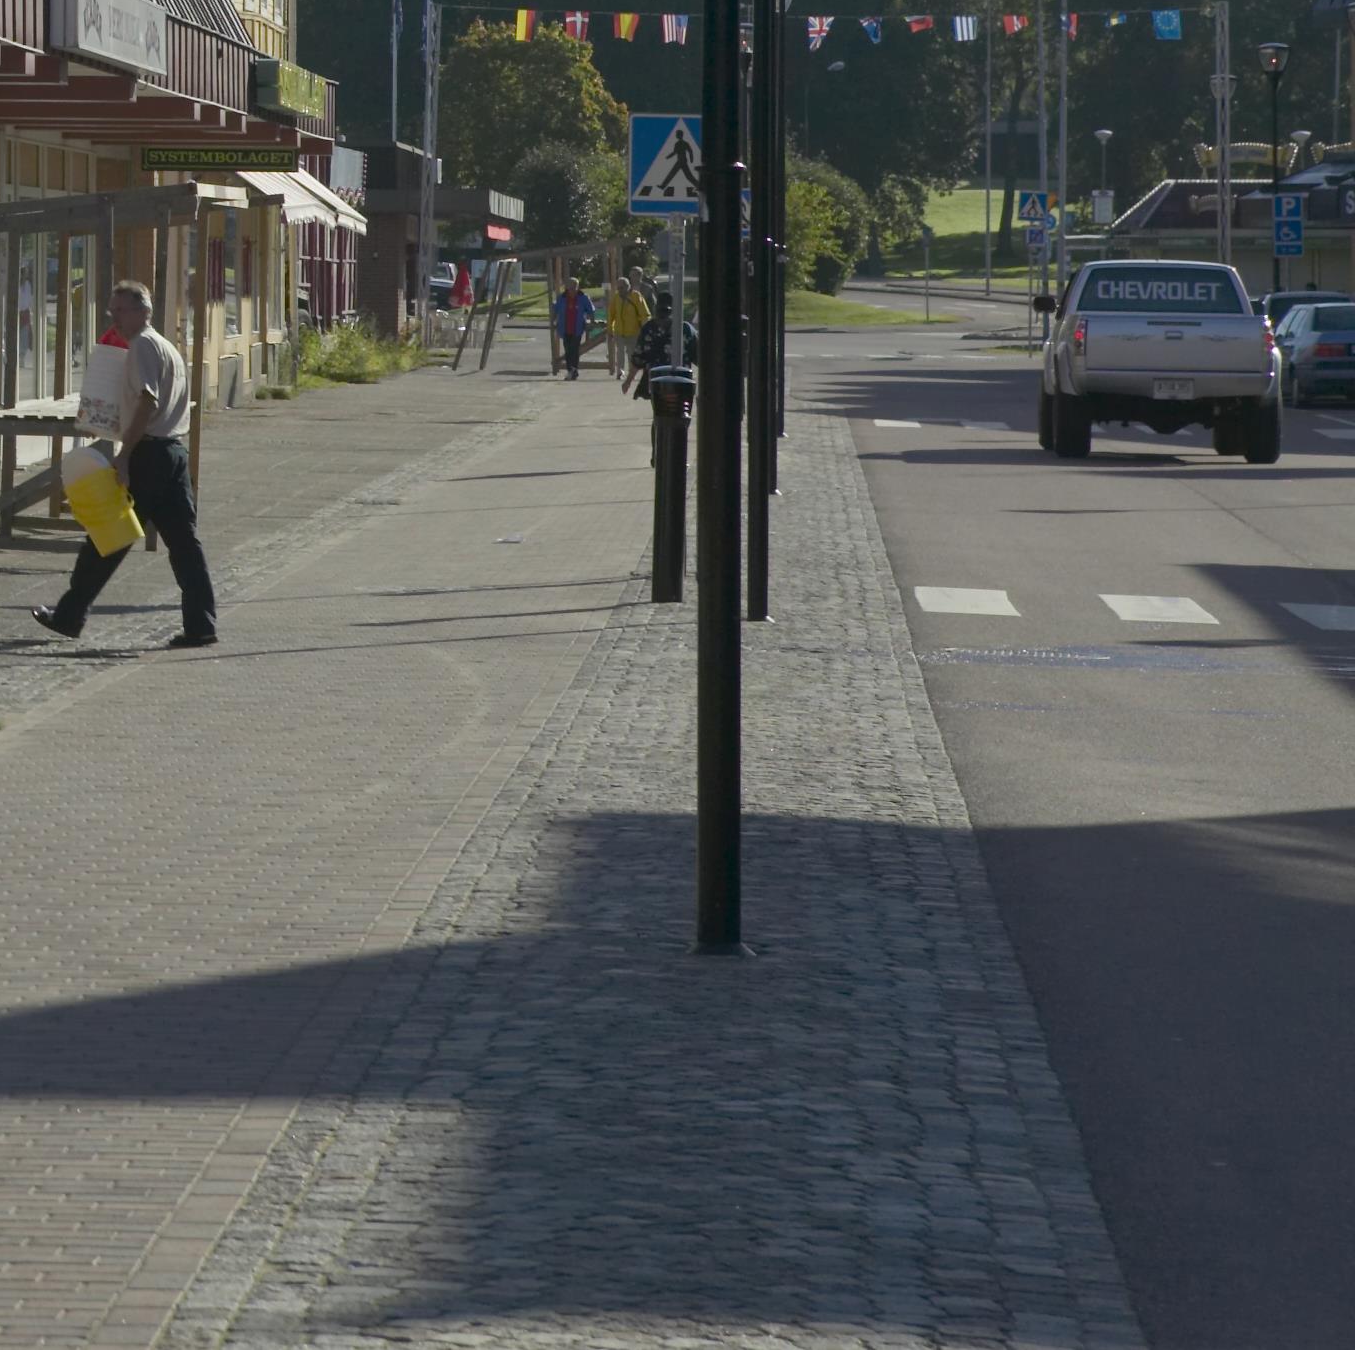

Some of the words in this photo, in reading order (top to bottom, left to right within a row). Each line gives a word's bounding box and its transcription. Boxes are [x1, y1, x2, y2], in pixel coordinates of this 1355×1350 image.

[148, 149, 292, 165] SYSTEMBOLAGET
[1281, 197, 1296, 216] P
[1096, 280, 1222, 301] CHEVROLET
